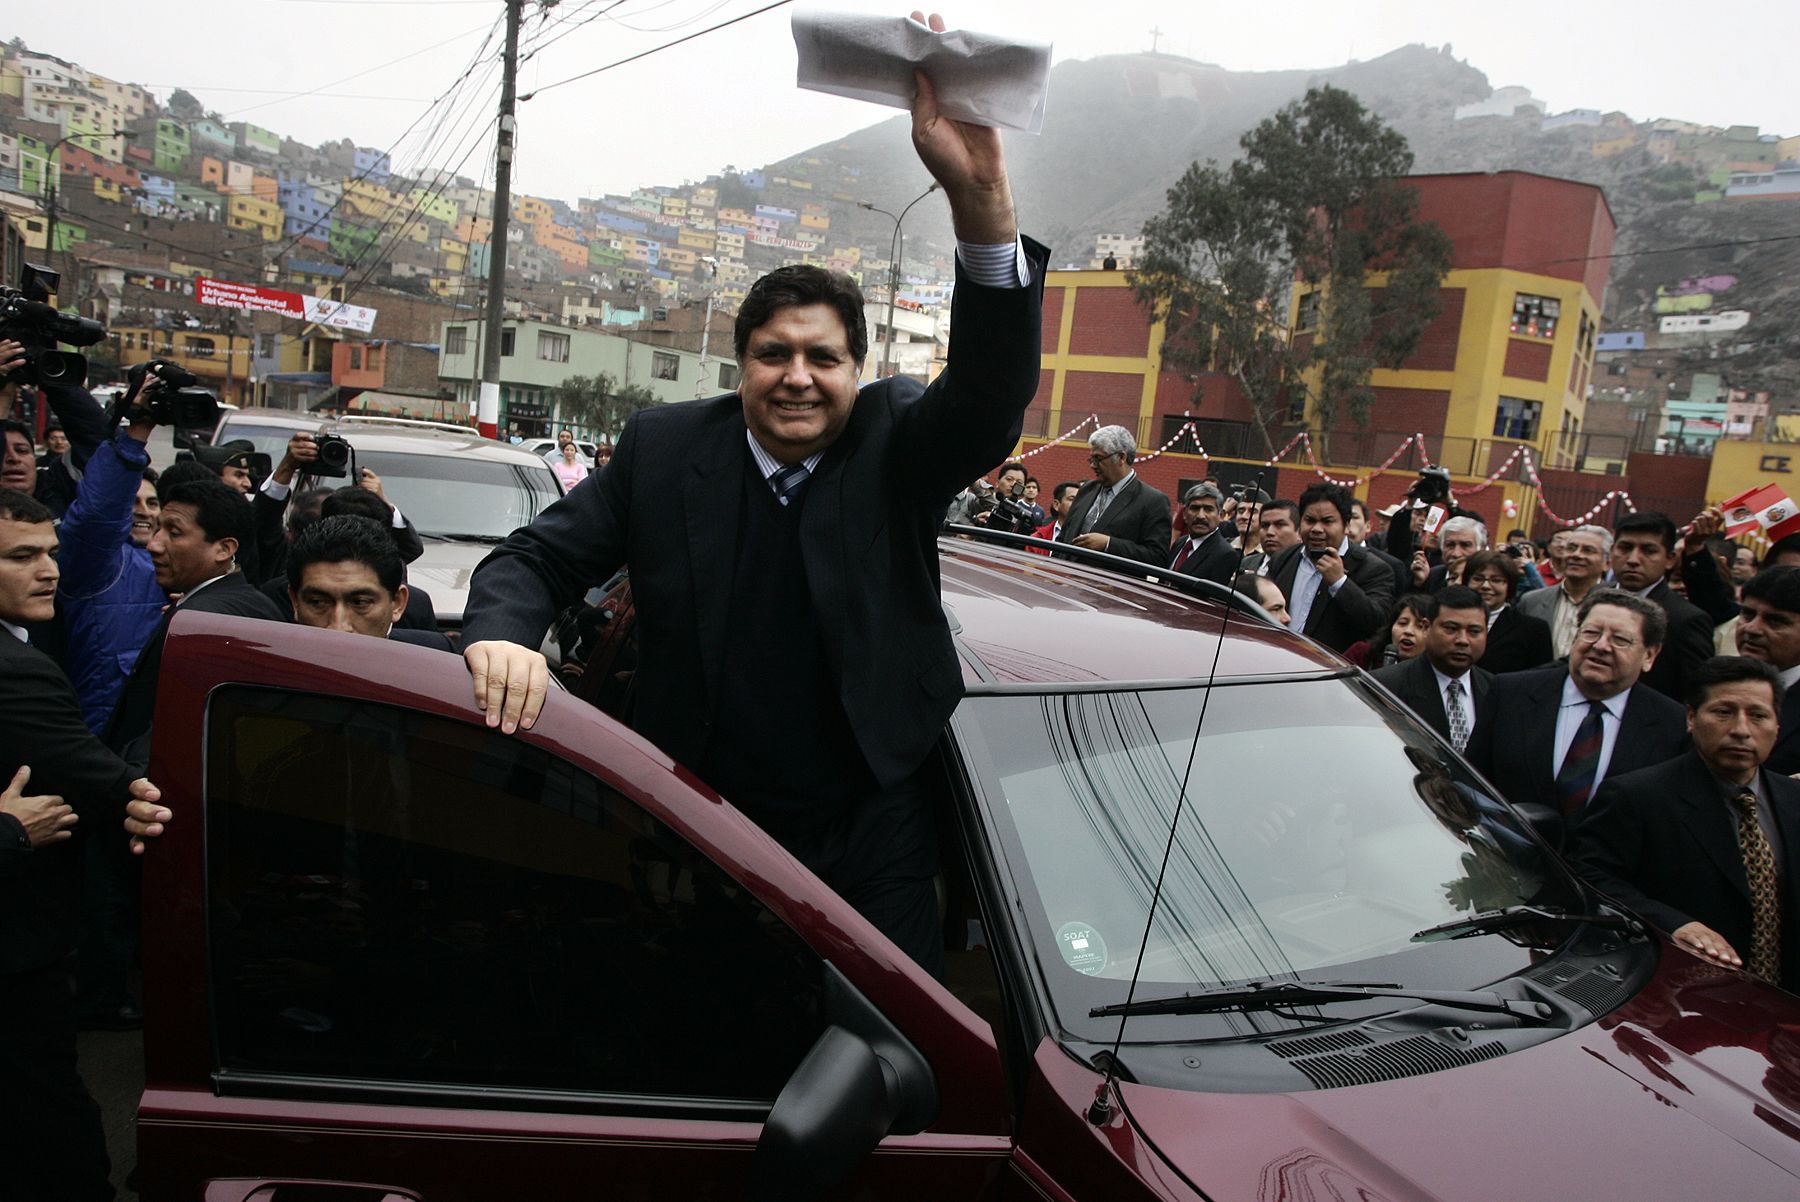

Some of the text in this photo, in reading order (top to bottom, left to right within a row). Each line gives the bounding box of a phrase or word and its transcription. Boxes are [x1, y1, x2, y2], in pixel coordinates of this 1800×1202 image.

[201, 295, 216, 305] del
[217, 297, 244, 309] Cerro
[202, 286, 287, 308] Urbano Ambiental
[1760, 455, 1792, 473] CE
[1063, 930, 1090, 941] SOAT
